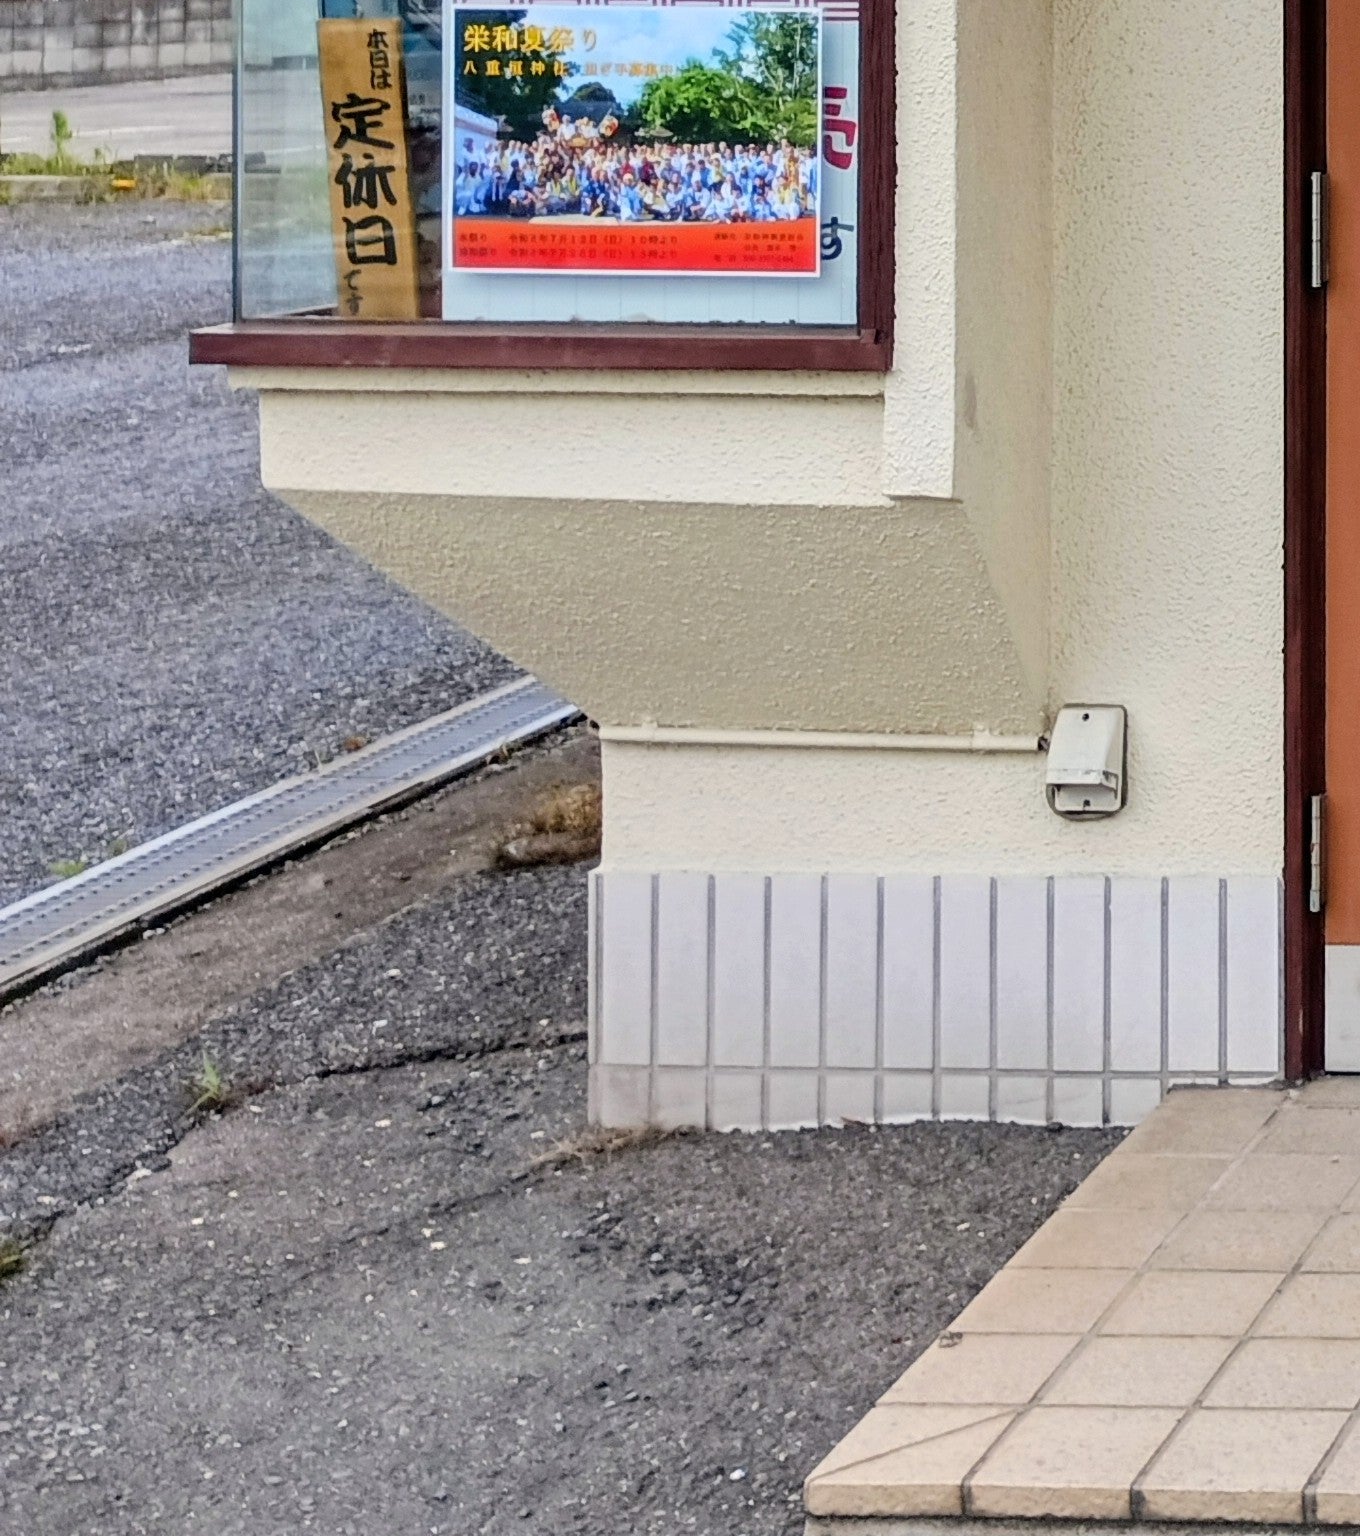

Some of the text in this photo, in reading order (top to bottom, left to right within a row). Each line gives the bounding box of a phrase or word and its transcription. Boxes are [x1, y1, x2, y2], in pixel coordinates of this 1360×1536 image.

[366, 27, 394, 91] 本日は
[463, 23, 598, 54] 栄和夏祭り
[331, 92, 399, 266] 定休日
[343, 268, 365, 315] です
